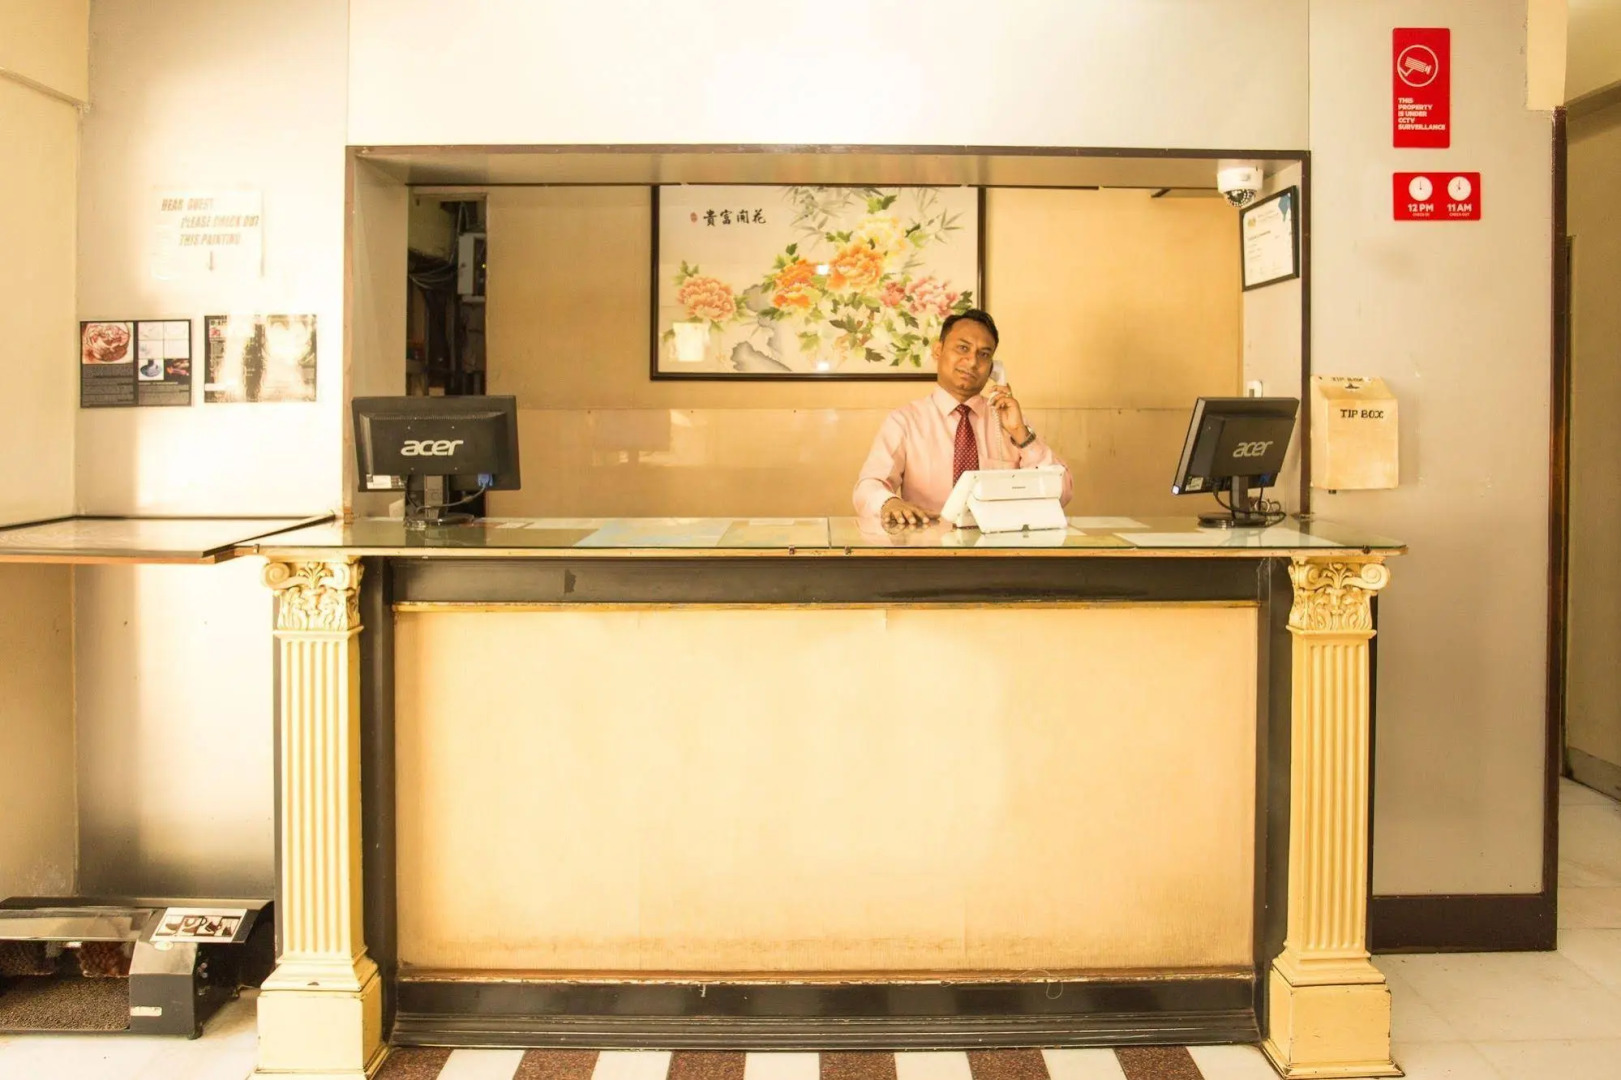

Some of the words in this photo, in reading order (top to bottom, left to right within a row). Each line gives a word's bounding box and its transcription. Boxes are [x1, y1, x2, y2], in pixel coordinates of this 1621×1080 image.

[1408, 204, 1418, 212] 12
[1419, 204, 1434, 212] PM
[1447, 204, 1456, 212] 11
[1457, 204, 1472, 212] AM
[1340, 409, 1358, 418] TIP
[1360, 410, 1384, 419] BOX
[400, 439, 464, 456] acer
[1232, 441, 1274, 458] acer
